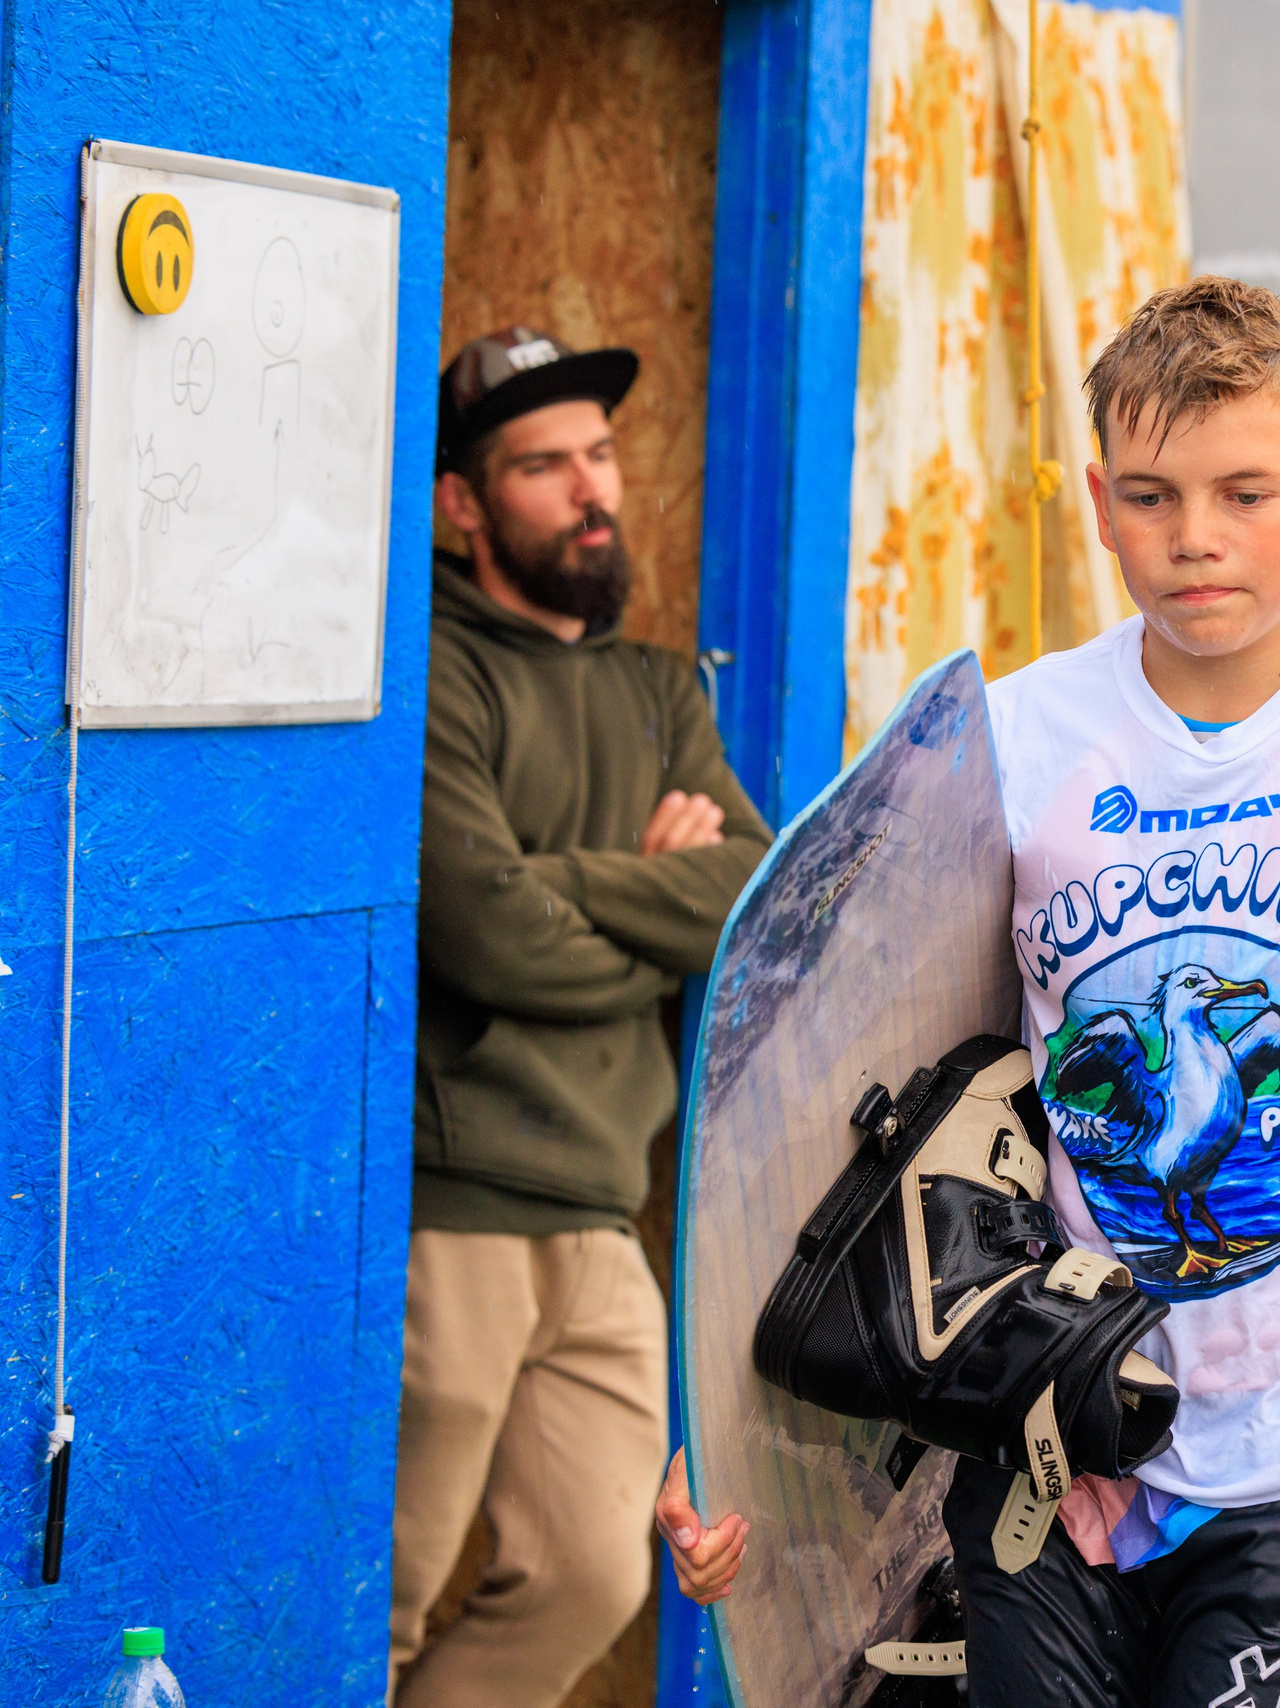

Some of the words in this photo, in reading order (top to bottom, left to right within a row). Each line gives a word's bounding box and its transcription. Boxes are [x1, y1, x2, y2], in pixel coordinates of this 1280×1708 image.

[817, 822, 890, 912] SLINGSHOT
[1043, 1102, 1113, 1146] WAKE
[948, 1289, 979, 1322] SLINGSHOT
[872, 1541, 909, 1594] THE
